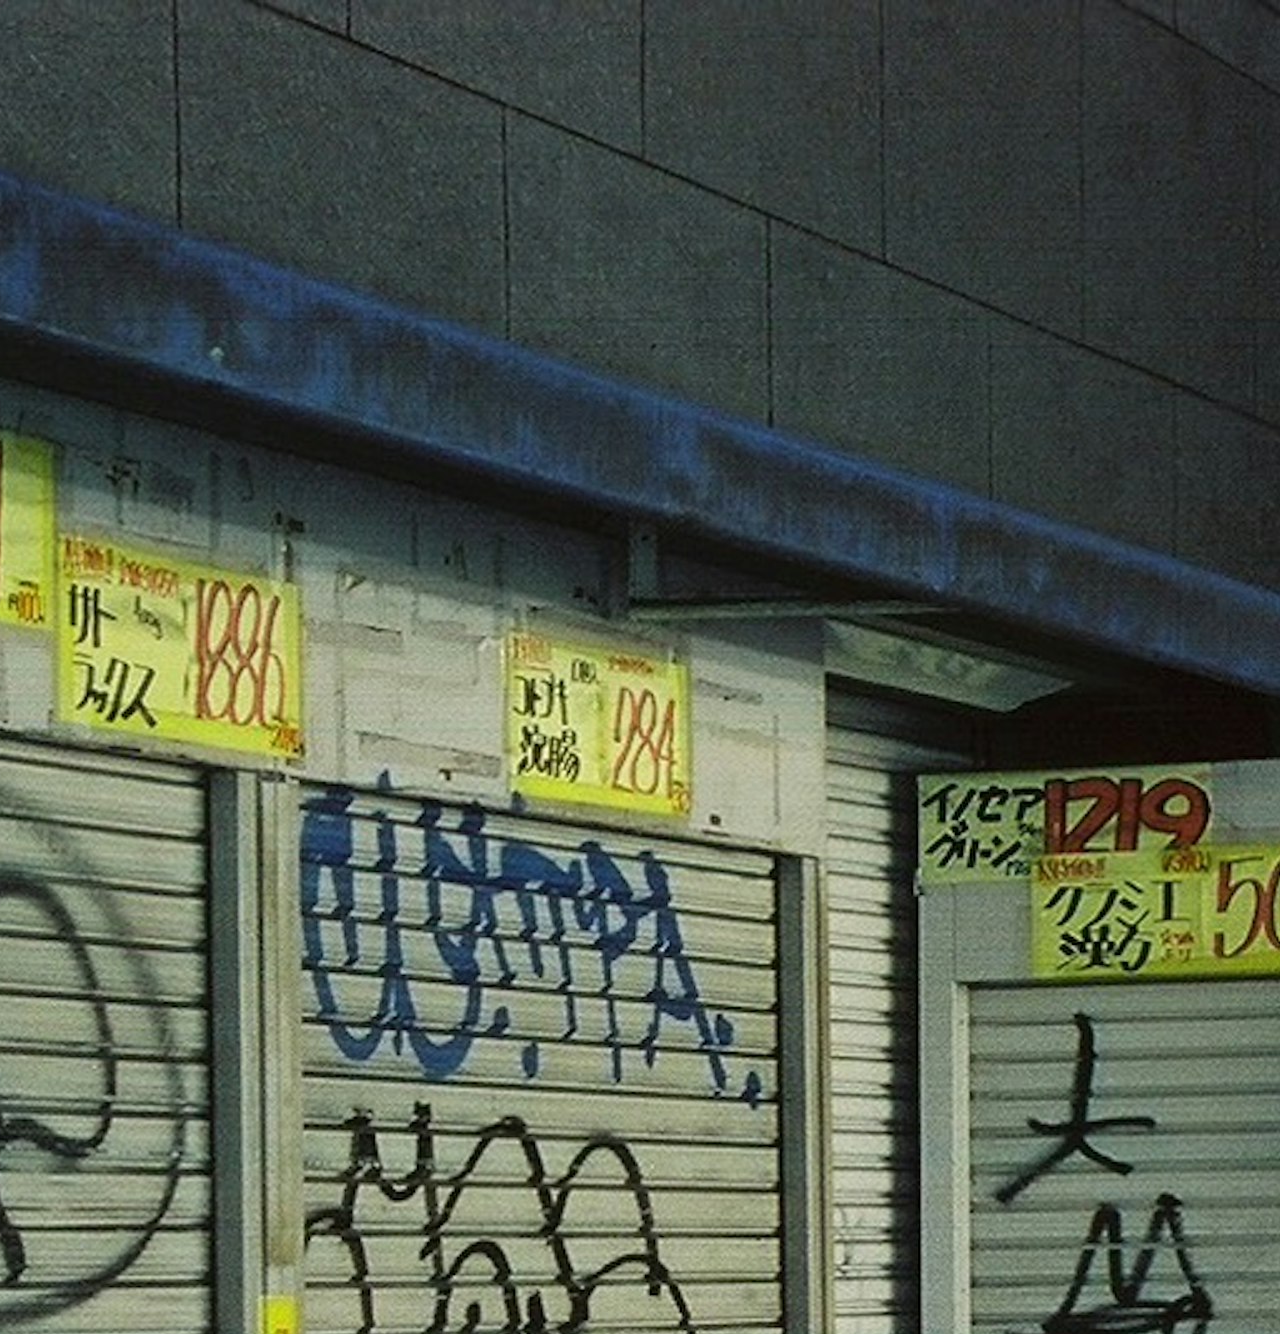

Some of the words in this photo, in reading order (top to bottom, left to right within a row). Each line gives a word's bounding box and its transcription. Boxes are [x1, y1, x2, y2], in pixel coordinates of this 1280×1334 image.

[196, 577, 287, 730] 1886
[611, 685, 676, 800] 284
[1042, 776, 1212, 854] 1219
